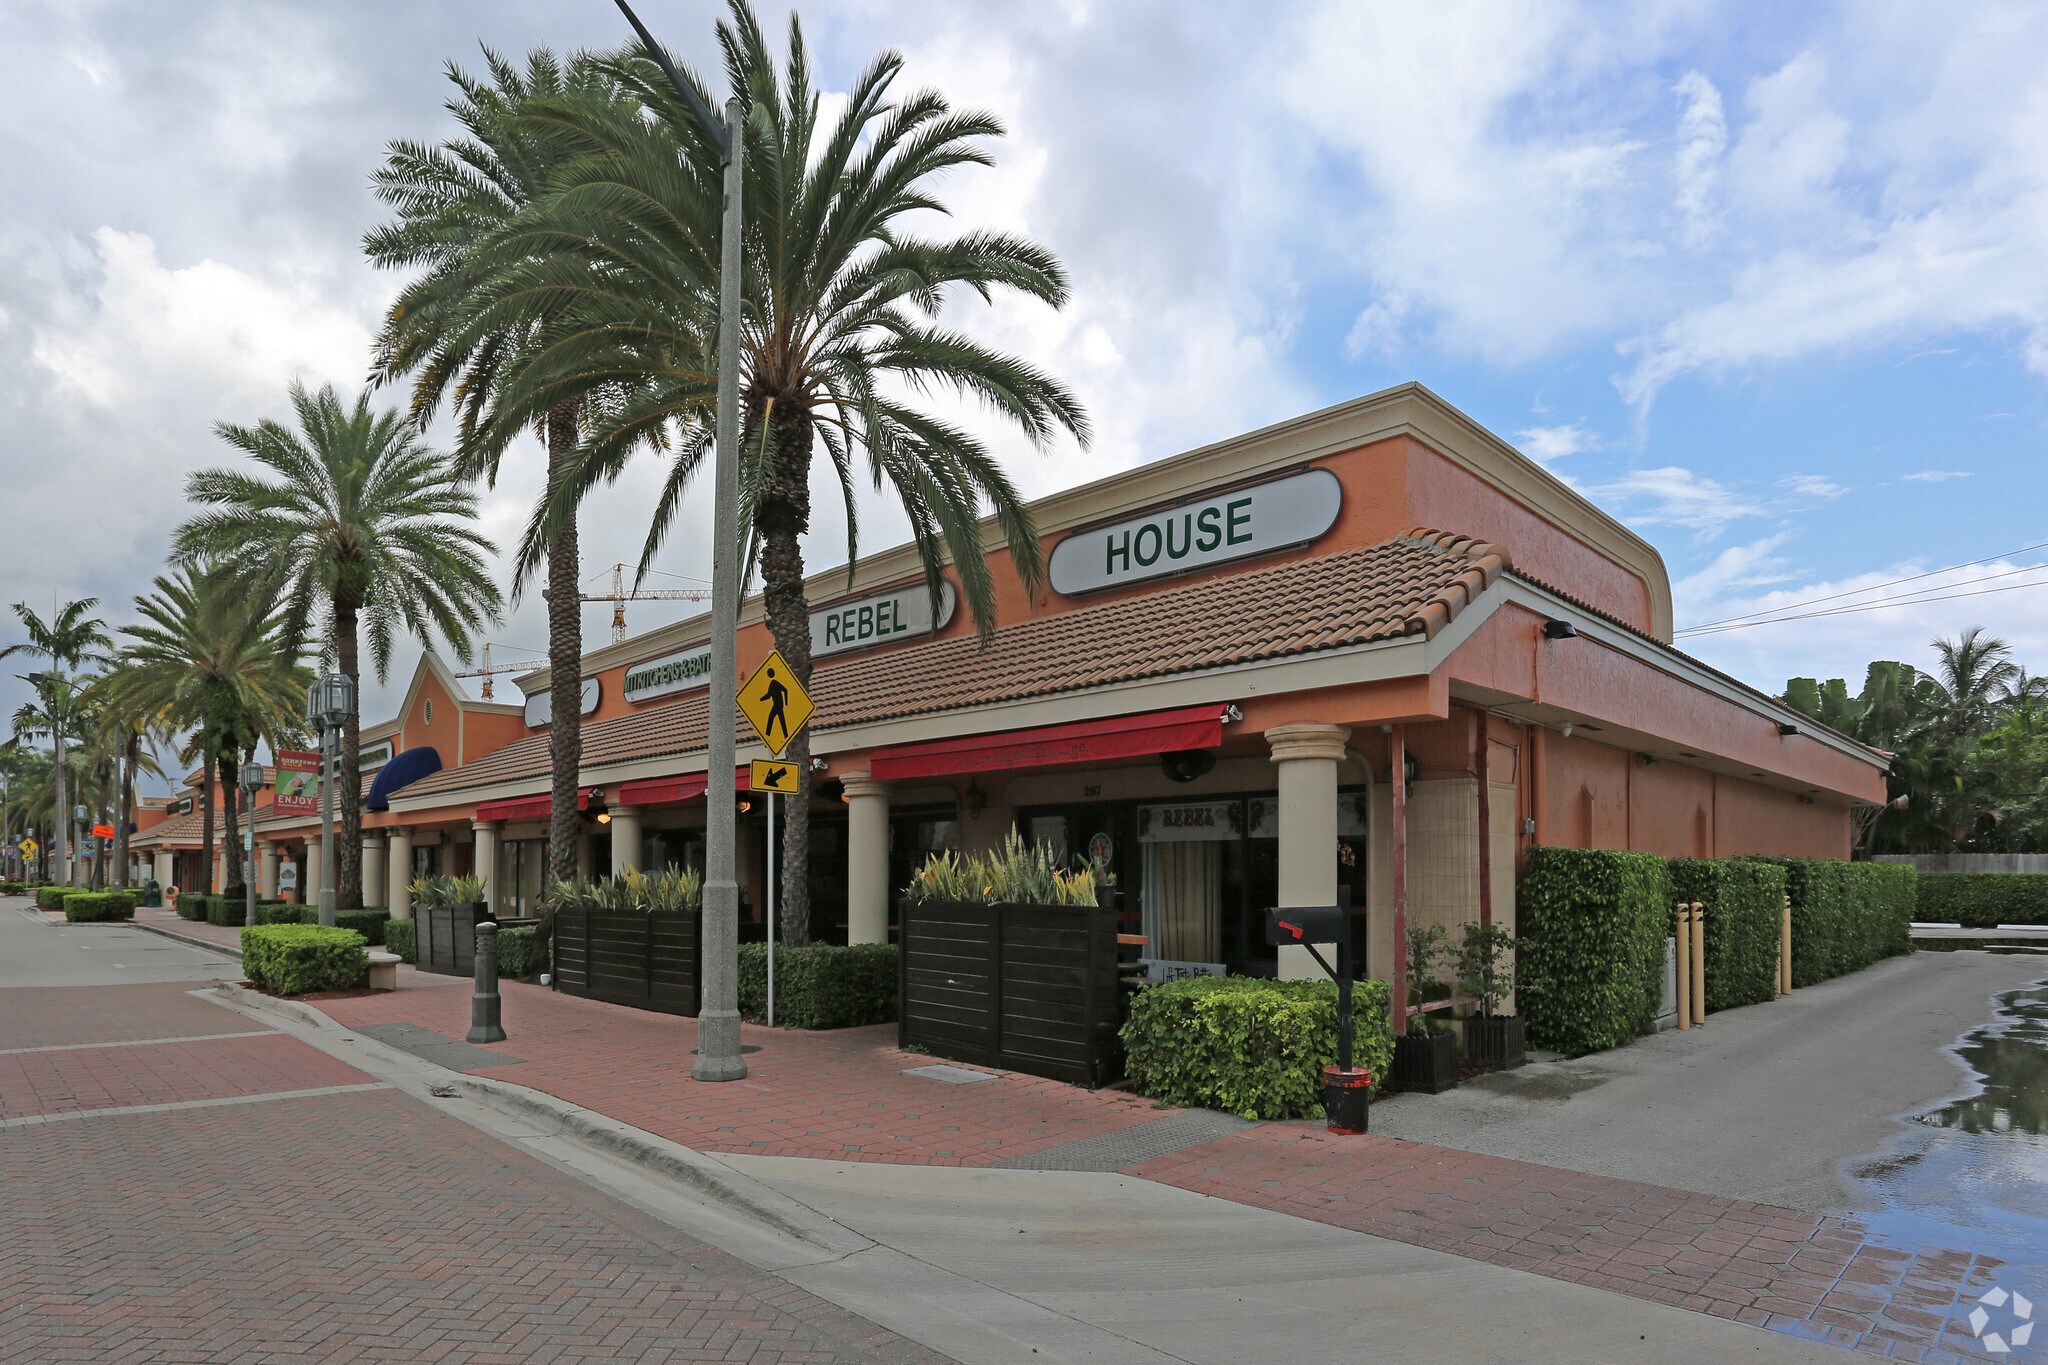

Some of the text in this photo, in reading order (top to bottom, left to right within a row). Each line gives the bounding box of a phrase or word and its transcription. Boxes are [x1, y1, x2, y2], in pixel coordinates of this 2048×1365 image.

[1106, 497, 1253, 576] HOUSE
[826, 599, 907, 647] REBEL
[281, 757, 317, 766] DOWNTOWN
[1083, 785, 1102, 797] 297
[277, 794, 313, 805] ENJOY
[1162, 807, 1215, 828] REBEL
